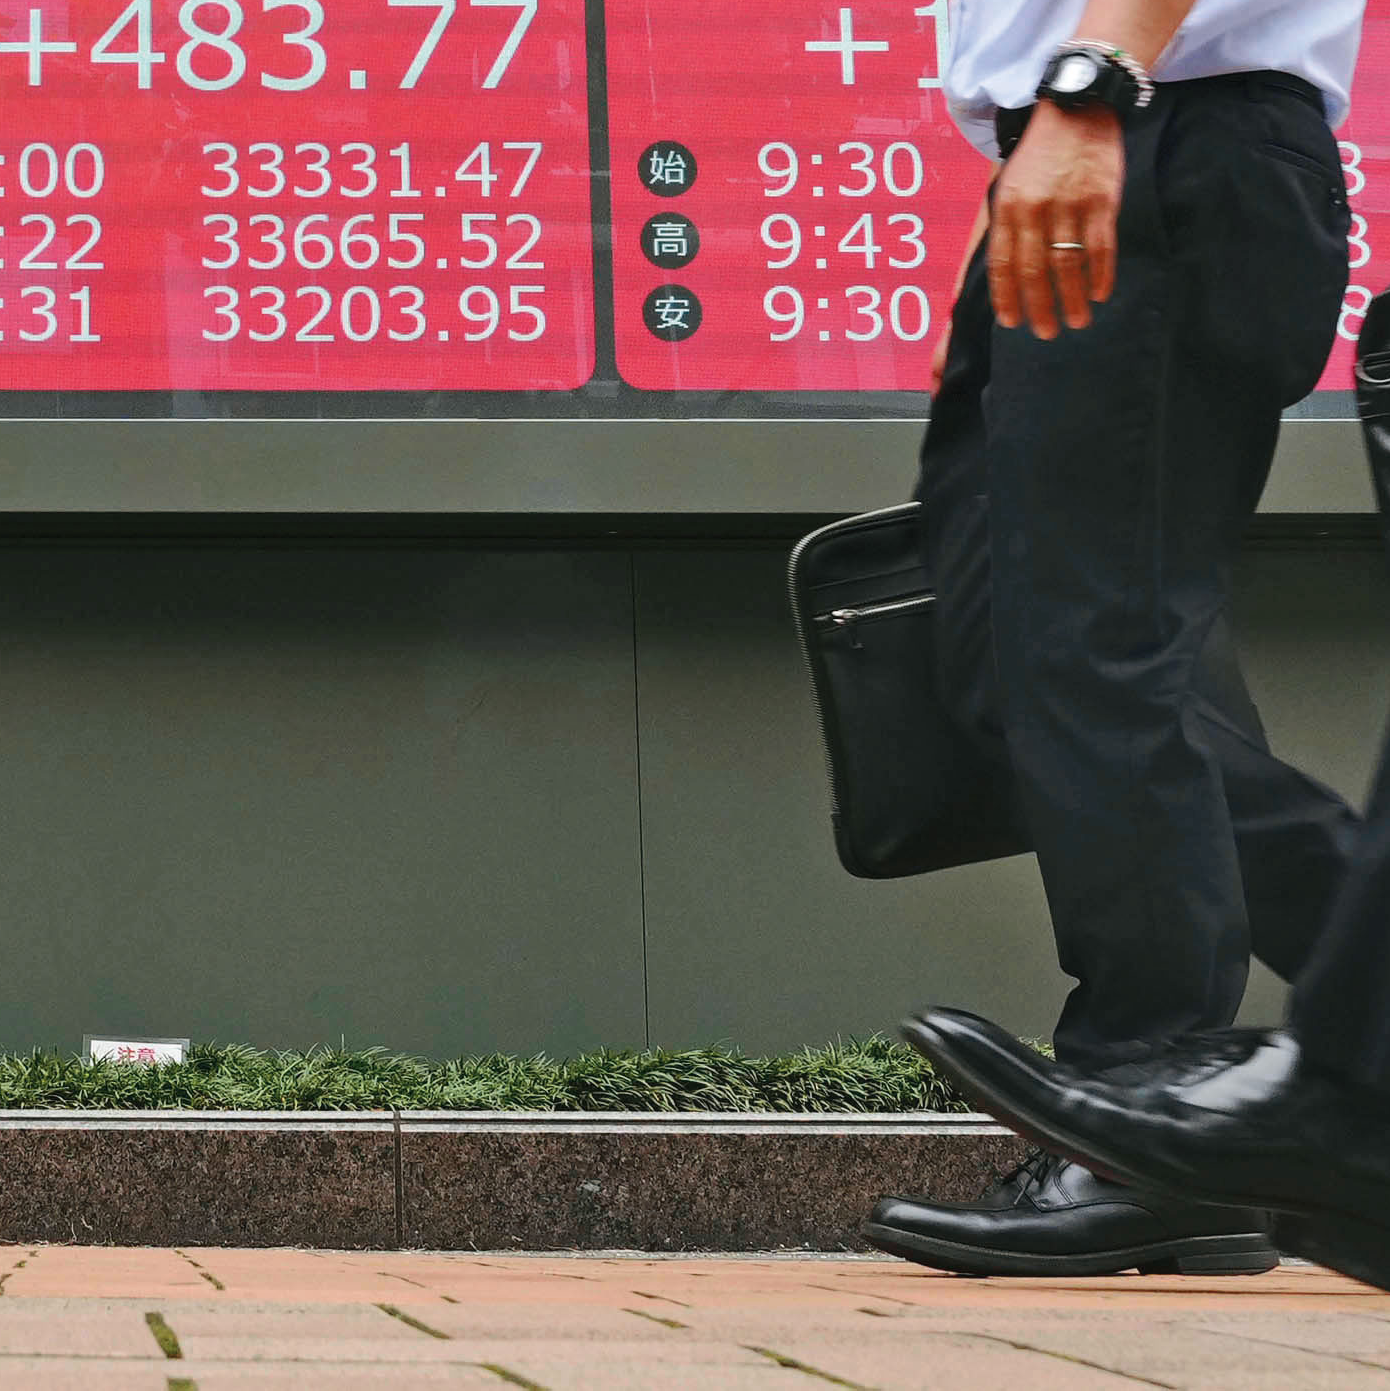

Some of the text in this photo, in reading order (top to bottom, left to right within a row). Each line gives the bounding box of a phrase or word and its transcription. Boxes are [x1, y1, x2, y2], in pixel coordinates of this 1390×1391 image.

[201, 141, 543, 198] 33331.47
[649, 141, 924, 197] 始 9:30
[201, 213, 545, 270] 33665.52
[651, 213, 927, 269] 高 9:43
[202, 285, 546, 342] 33203.95
[654, 285, 931, 342] 安 9:30
